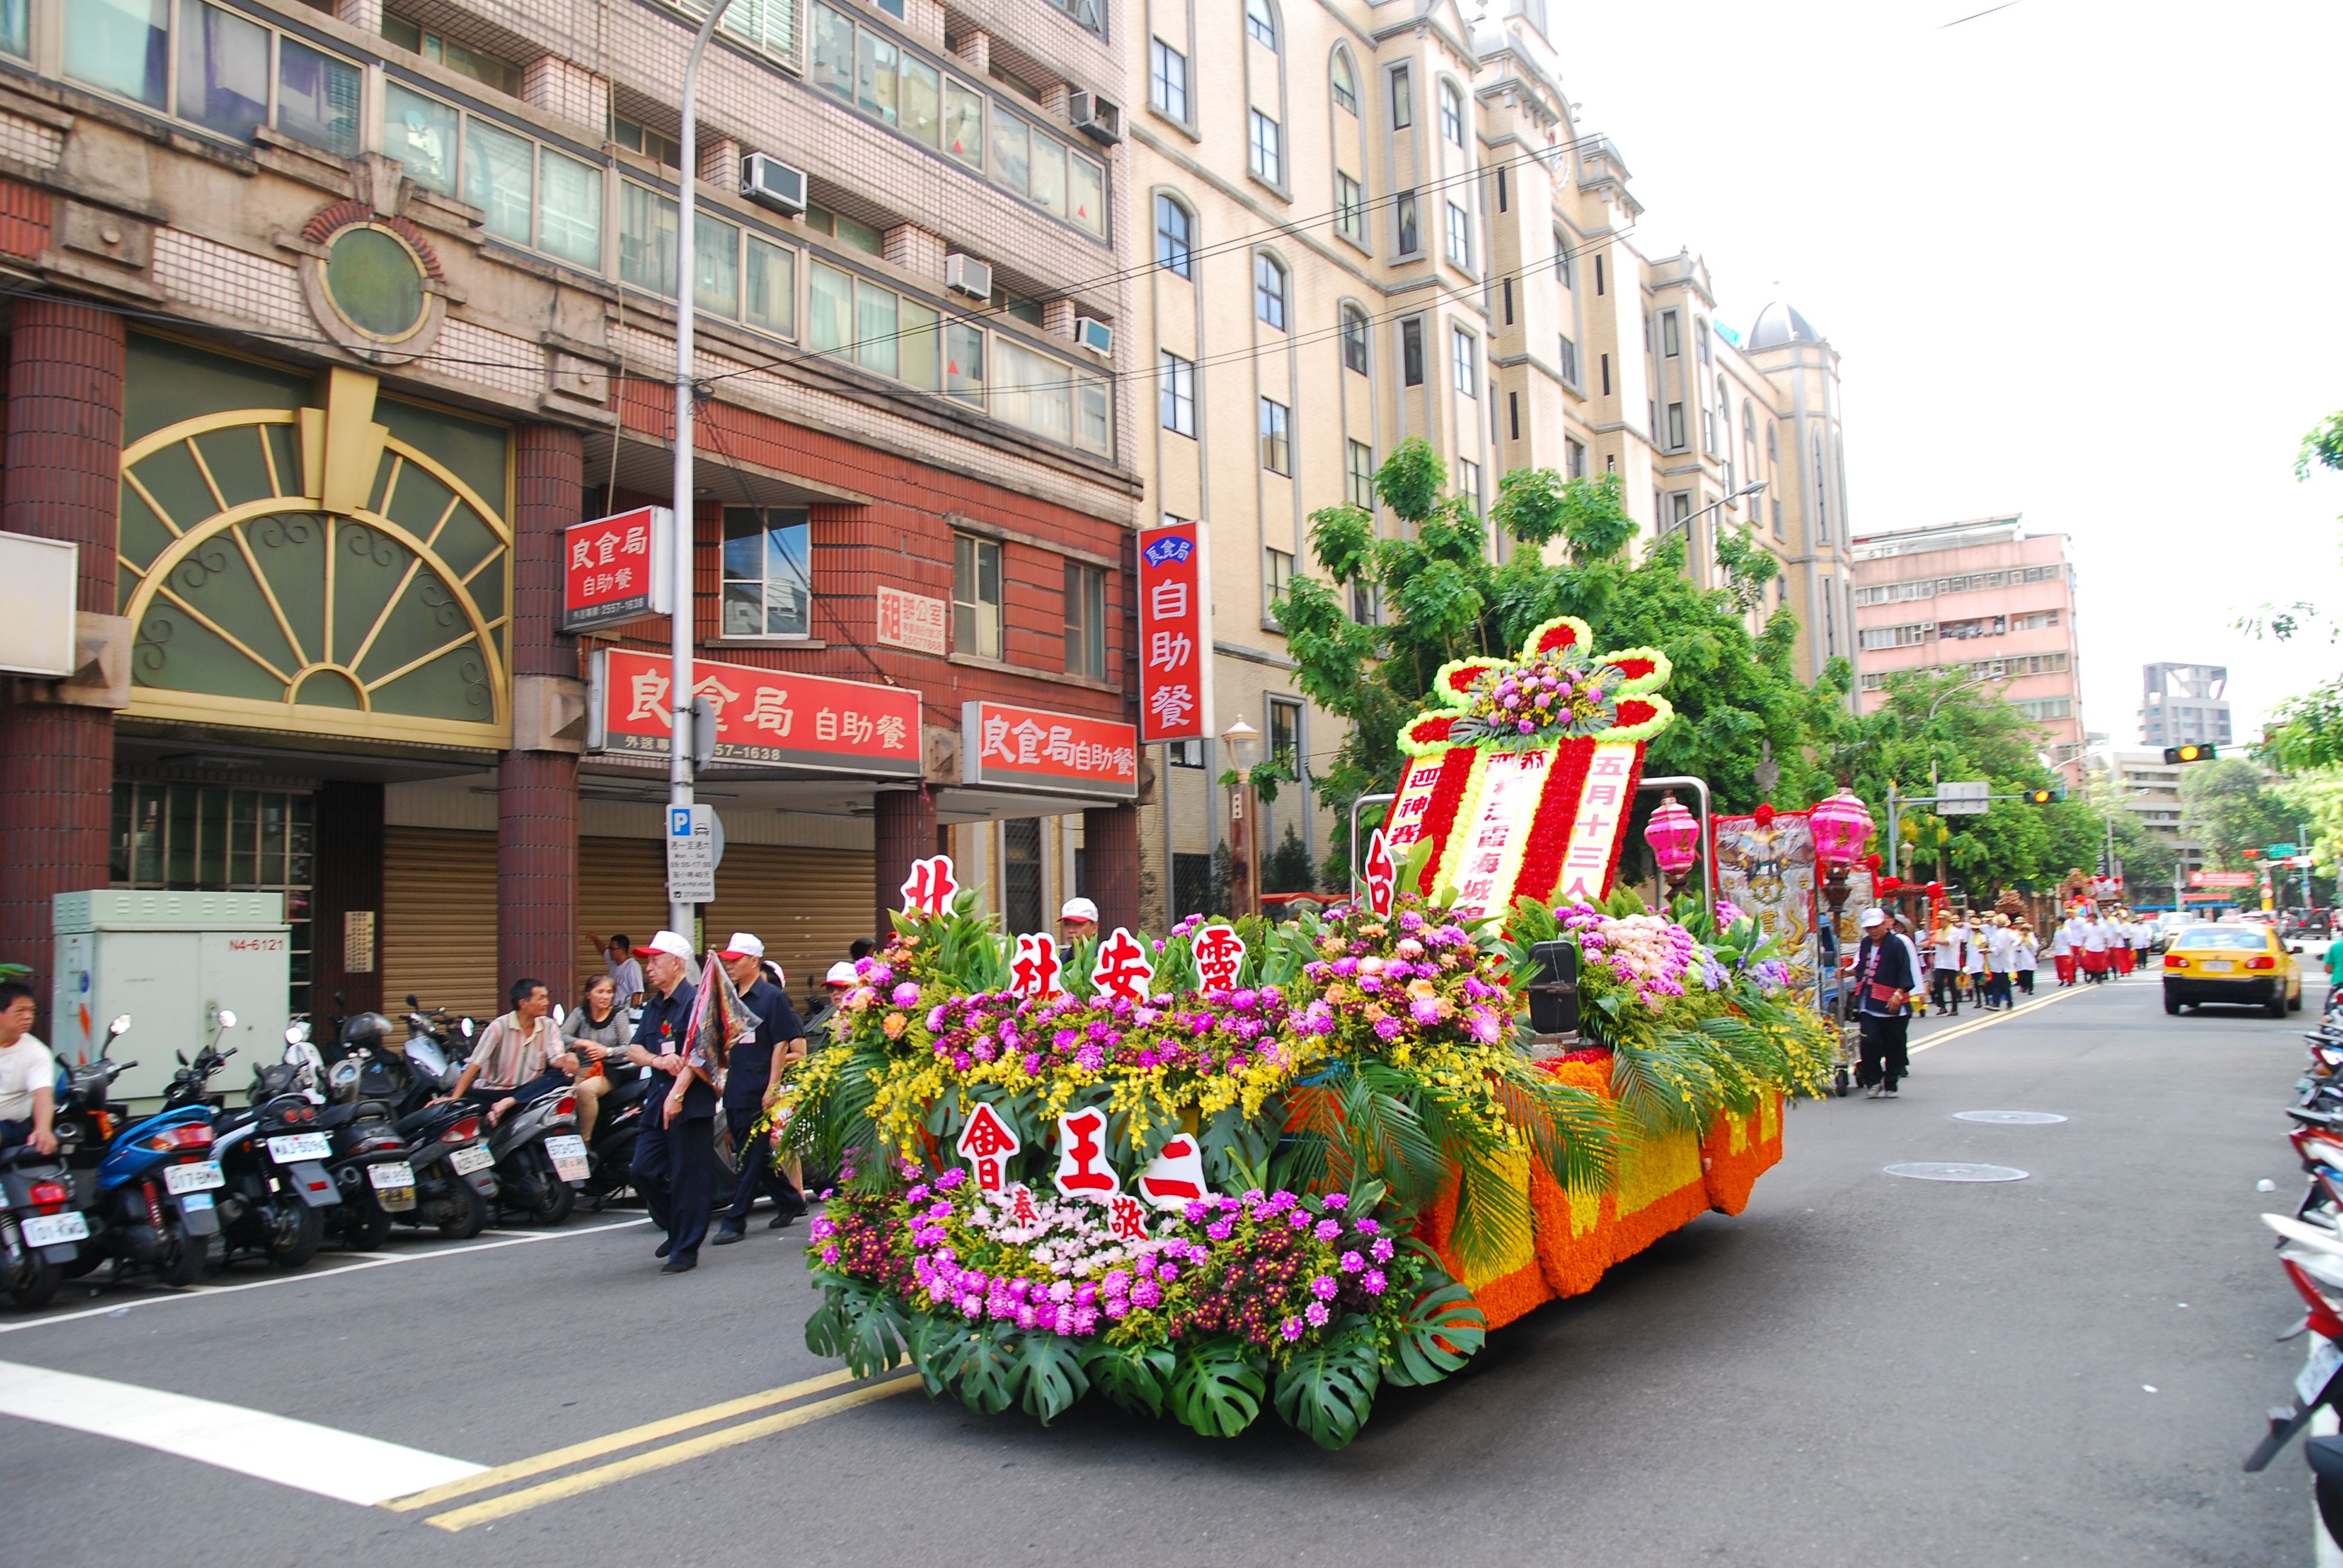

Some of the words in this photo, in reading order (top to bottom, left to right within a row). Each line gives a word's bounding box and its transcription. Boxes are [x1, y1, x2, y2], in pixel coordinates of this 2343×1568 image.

[571, 526, 647, 570] 良食局
[1145, 538, 1190, 567] 良食局
[583, 567, 632, 596] 自助餐
[1150, 578, 1193, 729] 自助餐
[626, 668, 793, 737] 良食局
[816, 707, 907, 750] 自助餐
[714, 744, 781, 760] 57-1638
[981, 714, 1075, 766] 良食局
[1075, 740, 1135, 776] 自助餐
[673, 812, 689, 832] P
[1389, 767, 1441, 854] 迎神賽
[1565, 757, 1625, 897] 五月十三人
[229, 939, 283, 950] N4-6121
